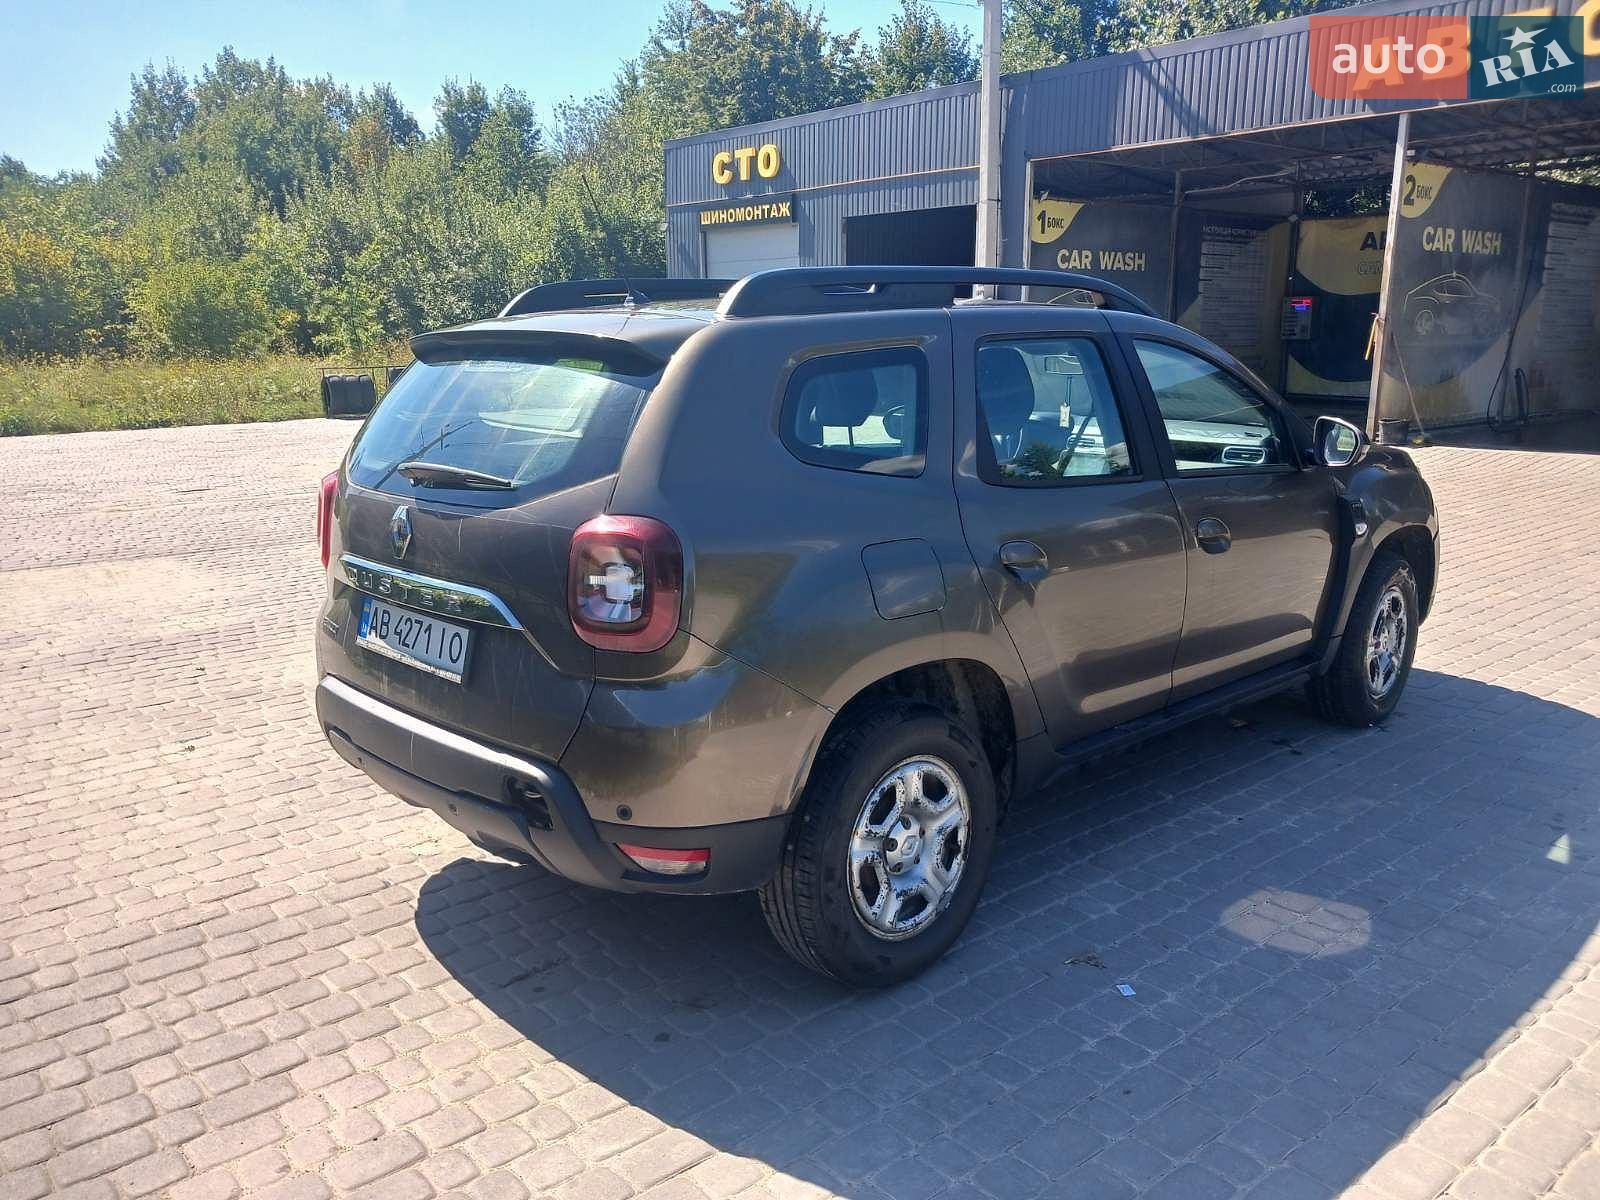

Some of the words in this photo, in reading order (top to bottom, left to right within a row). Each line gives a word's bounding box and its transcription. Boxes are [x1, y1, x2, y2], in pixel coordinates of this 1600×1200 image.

[713, 143, 780, 184] СТО
[1403, 174, 1416, 206] 2
[1416, 183, 1432, 200] БОКС
[700, 202, 790, 225] ШИНОМОНТАЖ
[1037, 209, 1046, 234] 1
[1047, 216, 1064, 229] БОКС
[1422, 226, 1456, 253] CAR
[1462, 229, 1502, 255] WASH
[1057, 248, 1092, 270] CAR
[1100, 250, 1146, 271] WASH
[368, 607, 391, 640] AB
[394, 614, 433, 655] 4271
[438, 626, 463, 664] IO
